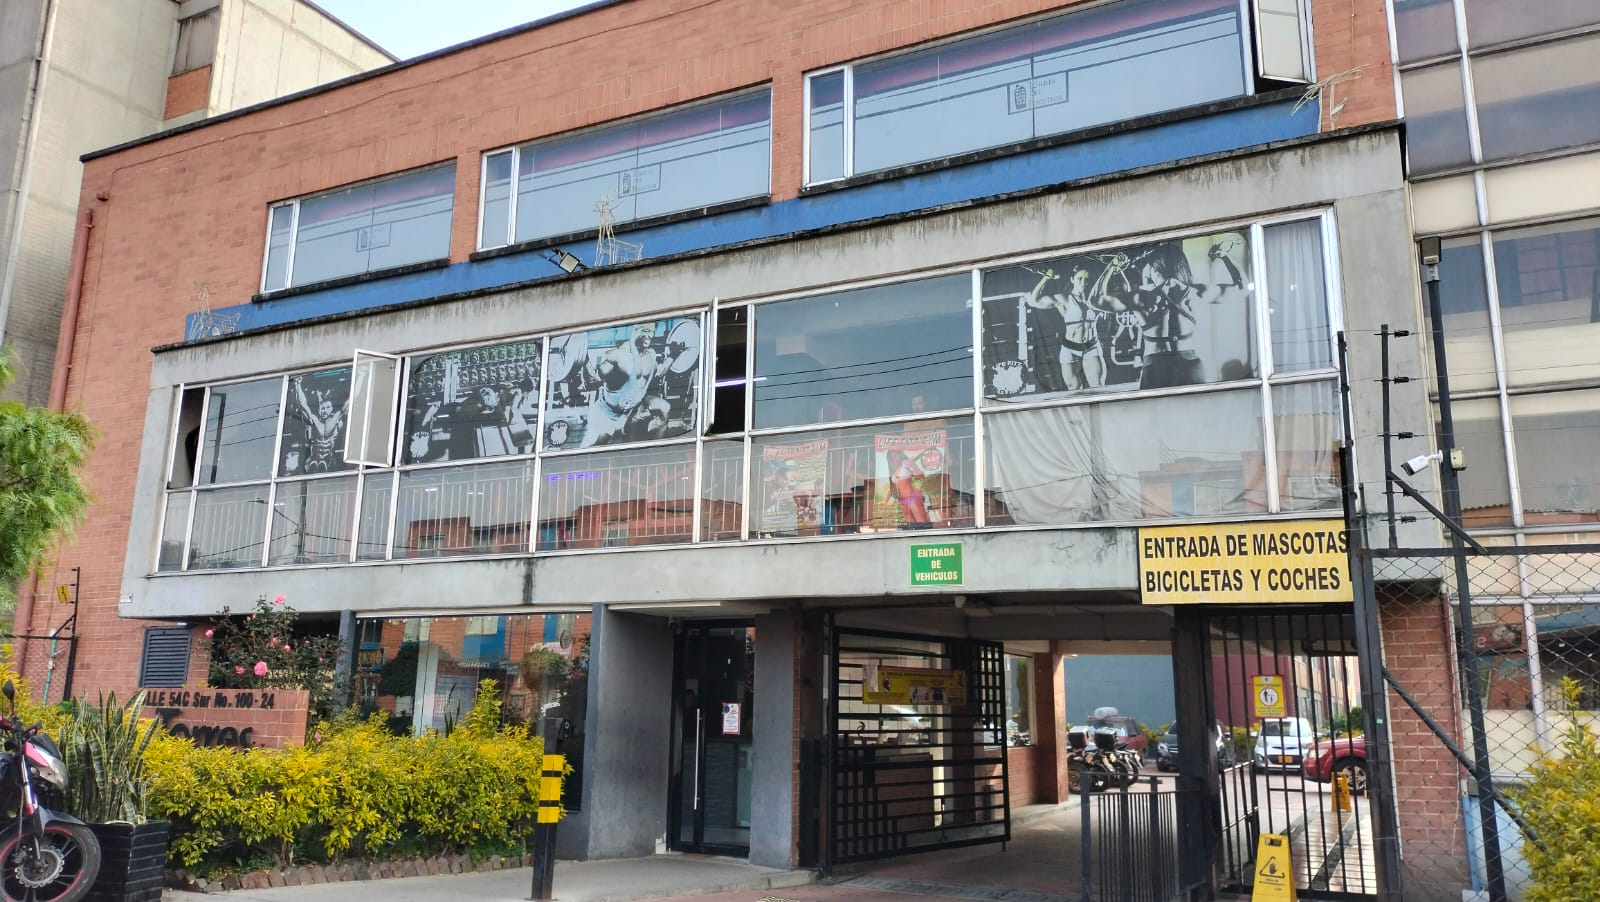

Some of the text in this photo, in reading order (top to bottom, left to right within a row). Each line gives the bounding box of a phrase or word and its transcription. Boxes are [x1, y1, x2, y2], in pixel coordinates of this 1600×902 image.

[1143, 530, 1348, 559] ENTRADA DE MASCOTAS
[917, 547, 956, 558] ENTRADA
[931, 559, 942, 569] DE
[915, 570, 958, 582] VEHICULOS
[1145, 566, 1341, 593] BICICLETAS Y COCHES
[169, 691, 190, 707] 54C
[192, 692, 211, 708] Sur
[214, 692, 232, 708] No.
[260, 692, 275, 709] 24
